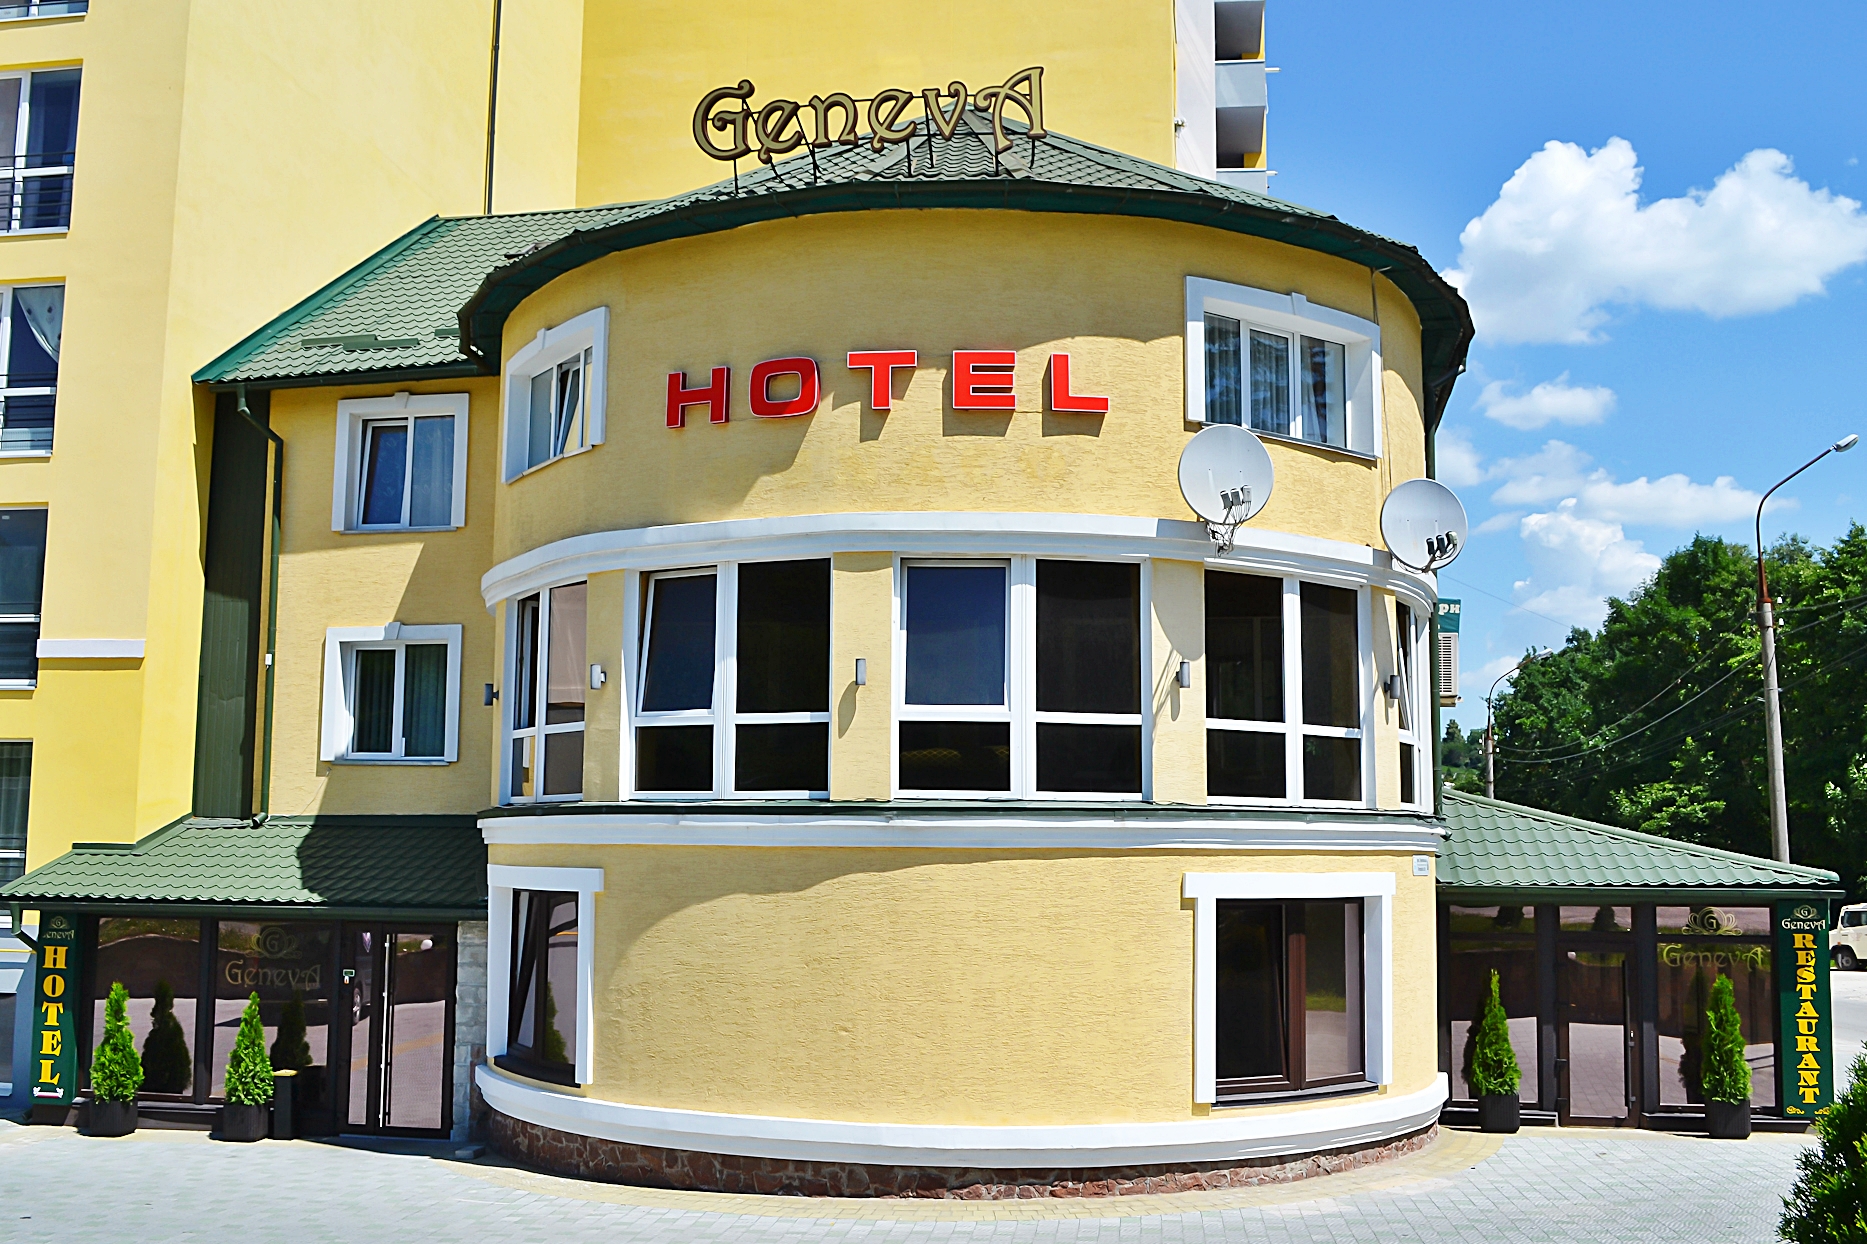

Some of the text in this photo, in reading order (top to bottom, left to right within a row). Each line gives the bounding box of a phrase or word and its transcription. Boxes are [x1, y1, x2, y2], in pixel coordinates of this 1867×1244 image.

[666, 349, 1109, 428] HOTEL
[39, 945, 68, 1085] HOTEL
[1793, 933, 1821, 1104] RESTAURANT
